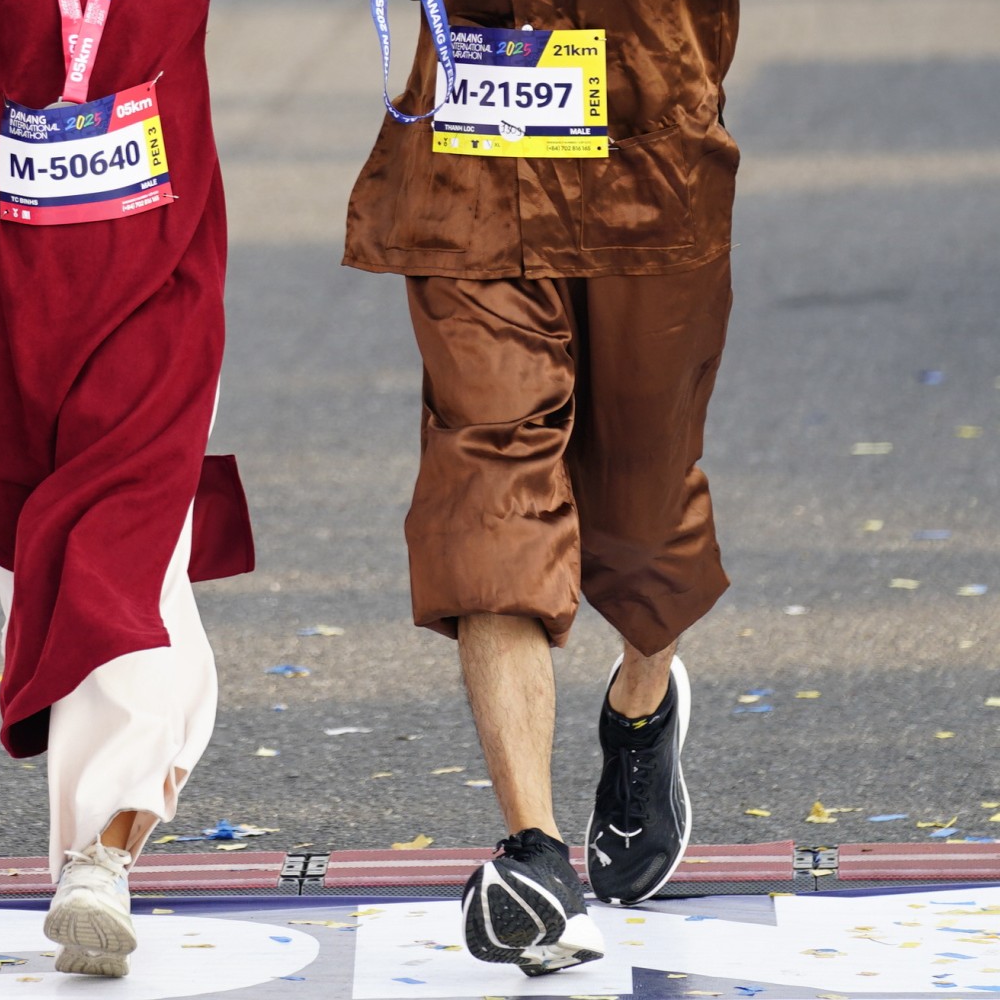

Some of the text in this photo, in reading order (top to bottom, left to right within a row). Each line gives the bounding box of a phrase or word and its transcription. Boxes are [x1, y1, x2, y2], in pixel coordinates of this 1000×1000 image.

[450, 32, 598, 56] DANANG 2025 21km
[451, 42, 493, 53] NTERNATIONAL
[70, 38, 94, 82] 05km
[446, 79, 573, 109] M-21597
[588, 77, 601, 117] PEN 3
[10, 108, 103, 131] DANANG 2025
[116, 98, 153, 119] 05km
[8, 126, 48, 139] MARATHON
[9, 119, 60, 132] INTERNATIONAL
[444, 124, 463, 132] THANH
[147, 126, 162, 166] PEN 3
[10, 140, 140, 181] M-50640
[141, 179, 158, 190] MALE
